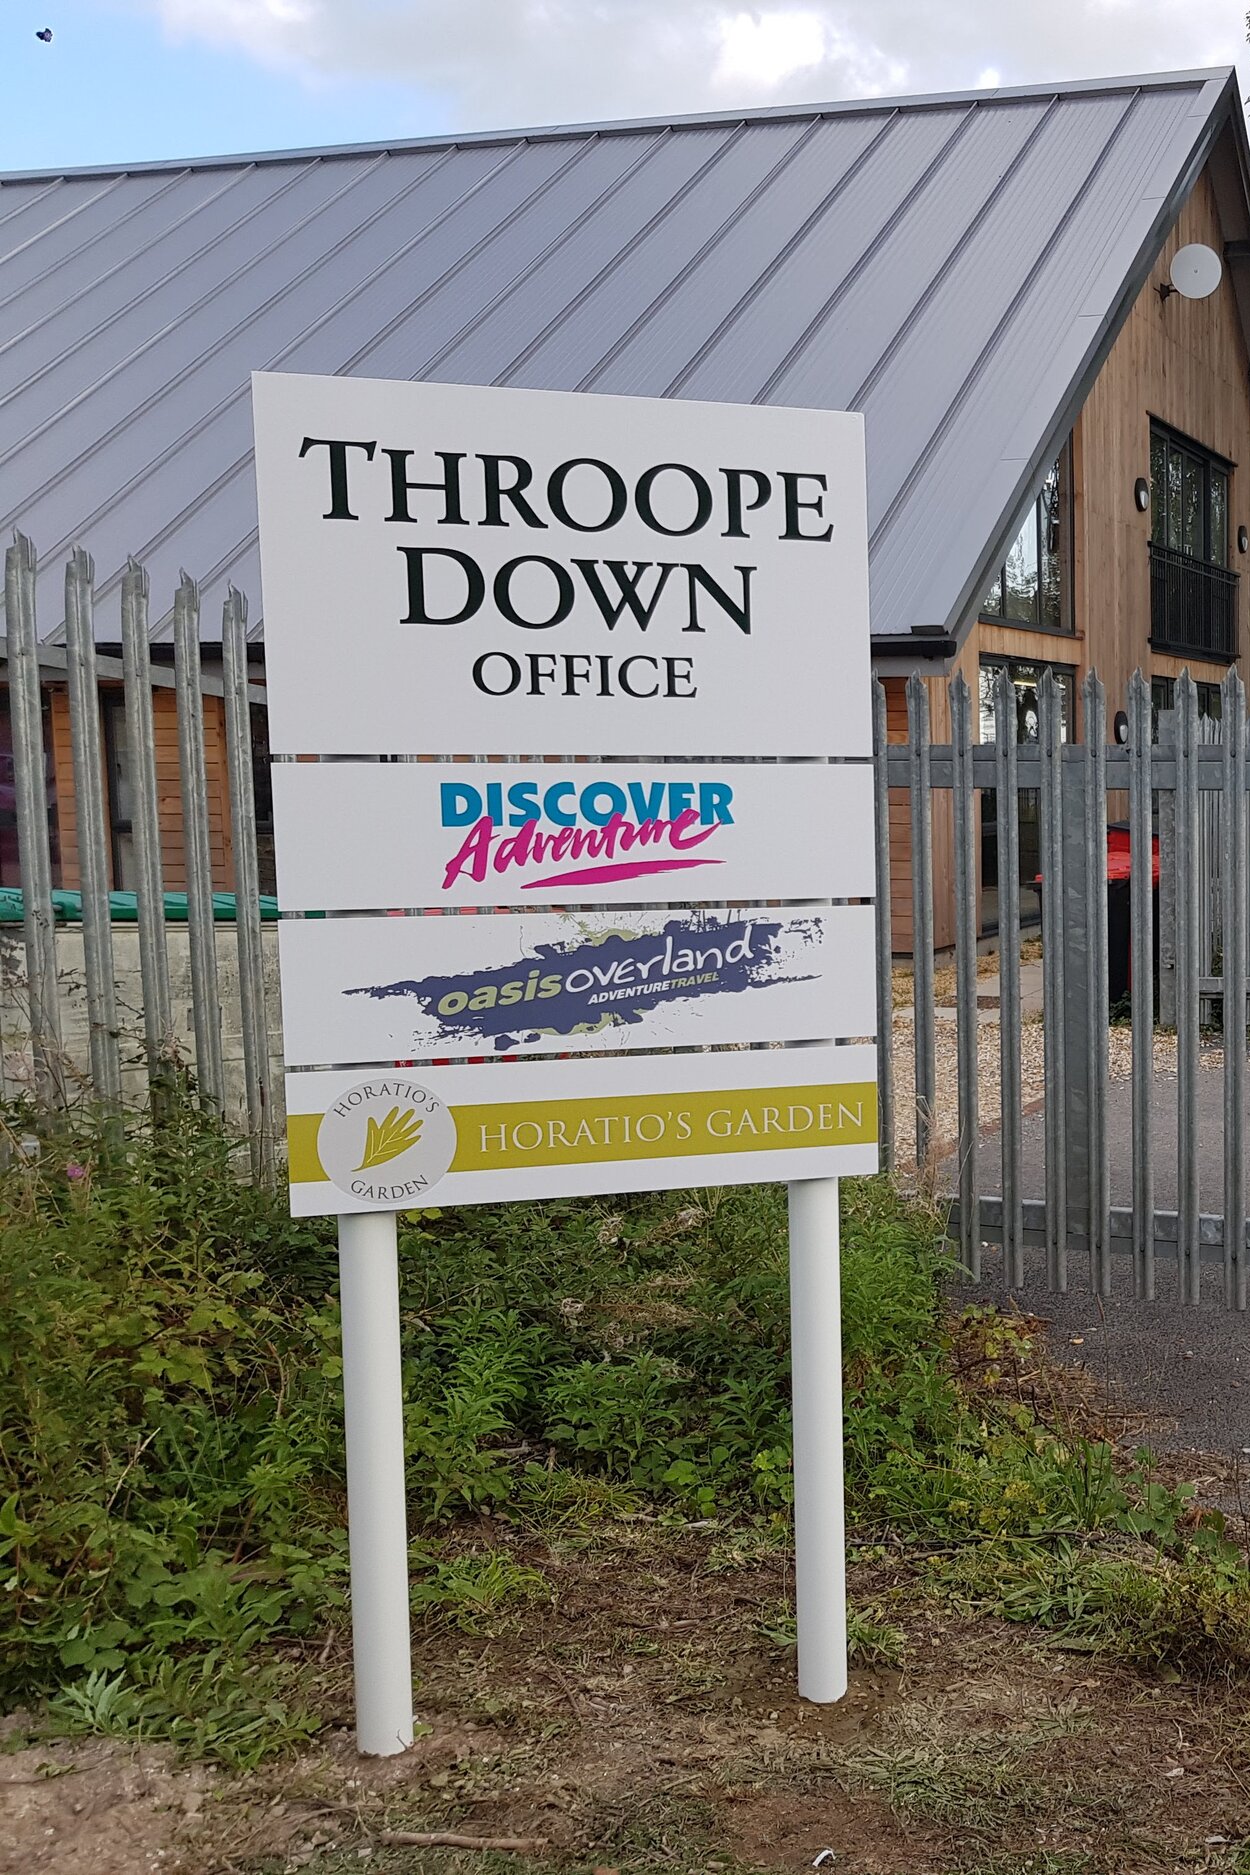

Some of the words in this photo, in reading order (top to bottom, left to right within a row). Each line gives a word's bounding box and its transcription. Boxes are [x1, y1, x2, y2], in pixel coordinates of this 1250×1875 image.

[298, 437, 835, 543] THROOPE
[396, 545, 758, 635] DOWN
[471, 652, 698, 699] OFFICE
[440, 781, 735, 828] DISCOVER
[441, 808, 723, 890] Adventure
[333, 1082, 440, 1118] HORATIO'S
[479, 1111, 693, 1153] HORATIO'S
[706, 1101, 864, 1138] GARDEN
[350, 1174, 429, 1200] GARDEN
